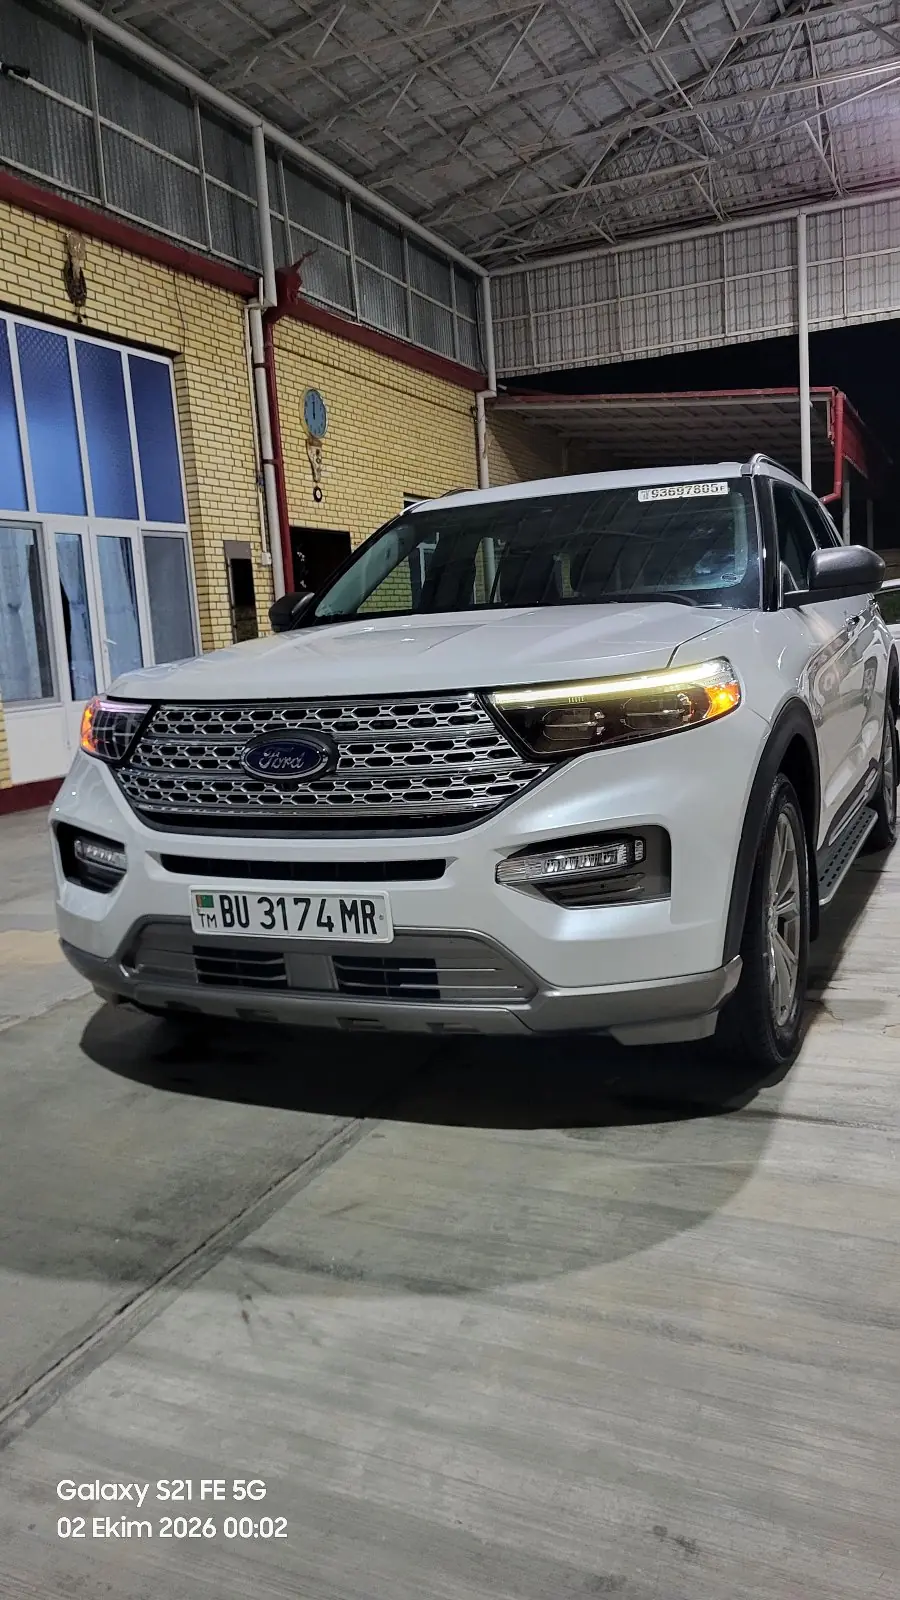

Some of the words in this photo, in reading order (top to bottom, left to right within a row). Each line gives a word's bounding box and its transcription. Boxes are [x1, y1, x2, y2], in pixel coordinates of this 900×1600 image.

[258, 747, 305, 769] Ford
[198, 913, 218, 928] TM
[219, 894, 250, 929] BU
[257, 896, 334, 932] 3174
[339, 899, 377, 935] MR
